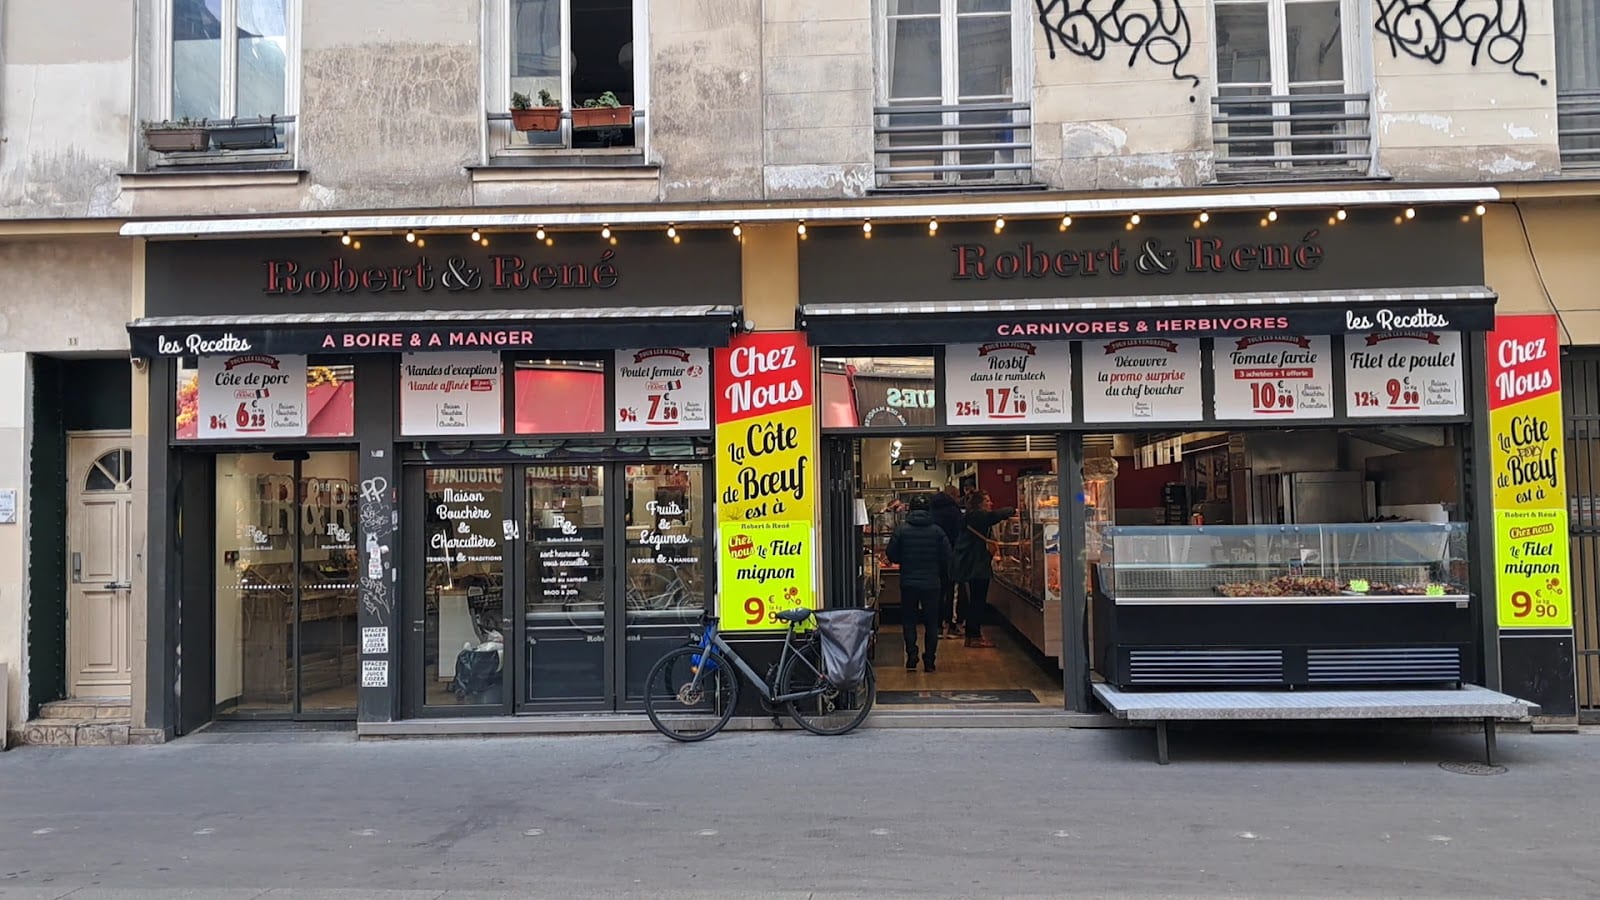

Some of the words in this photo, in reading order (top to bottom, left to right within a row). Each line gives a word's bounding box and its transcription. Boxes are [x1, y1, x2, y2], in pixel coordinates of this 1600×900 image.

[951, 240, 1127, 280] Robert
[1136, 237, 1176, 274] &
[1186, 230, 1324, 272] René
[263, 256, 434, 294] Robert
[442, 255, 482, 291] &
[489, 250, 618, 290] René
[997, 321, 1130, 336] CARNIVORES
[1136, 321, 1149, 332] &
[1156, 317, 1289, 332] HERBIVORES
[1346, 310, 1374, 330] les
[1376, 308, 1449, 331] Recettes
[158, 335, 183, 354] les
[186, 333, 252, 355] Recettes
[322, 335, 336, 348] A
[343, 333, 403, 347] BOIRE
[410, 334, 422, 347] &
[428, 334, 442, 346] A
[450, 331, 534, 346] MANGER
[729, 345, 796, 378] Chez
[1114, 355, 1168, 368] Découvrez
[1230, 351, 1278, 365] Tomate
[1278, 350, 1318, 368] farcie
[1498, 337, 1547, 368] Chez
[405, 364, 442, 377] Viandes
[443, 363, 498, 378] d'exceptions
[988, 355, 1029, 372] Rosbif
[1350, 352, 1383, 369] Filet
[1387, 353, 1406, 368] de
[1409, 352, 1455, 373] poulet
[215, 371, 241, 386] Côte
[244, 372, 260, 385] de
[261, 373, 290, 388] porc
[620, 366, 650, 378] Poulet
[650, 366, 686, 380] fermier
[970, 372, 994, 382] dans
[994, 372, 1003, 382] le
[1097, 371, 1108, 382] la
[1109, 372, 1143, 384] promo
[1145, 370, 1186, 384] surprise
[408, 380, 438, 391] Viande
[439, 380, 469, 393] affinée
[1105, 386, 1119, 396] du
[1121, 384, 1143, 399] chef
[1144, 384, 1185, 396] boucher
[1386, 378, 1401, 405] 9
[1495, 368, 1553, 401] Nous
[724, 379, 803, 414] Nous
[985, 388, 1011, 414] 17
[1250, 382, 1275, 408] 10
[236, 402, 249, 427] 6
[648, 394, 661, 420] 7
[727, 442, 745, 465] La
[747, 421, 798, 457] Côte
[1497, 432, 1511, 454] La
[1511, 415, 1550, 446] Côte
[1497, 472, 1511, 488] de
[1507, 447, 1559, 488] Bœuf
[722, 485, 739, 504] de
[737, 455, 808, 501] Bœuf
[443, 487, 485, 503] Maison
[1516, 488, 1532, 504] est
[1536, 485, 1546, 500] à
[436, 504, 492, 520] Bouchère
[645, 500, 683, 516] Fruits
[745, 502, 767, 519] est
[773, 498, 787, 514] à
[457, 521, 471, 534] &
[658, 518, 671, 530] &
[1510, 527, 1531, 539] Chez
[1532, 524, 1553, 535] nous
[431, 533, 497, 549] Charcutière
[639, 529, 690, 551] Légumes
[729, 535, 752, 547] Chez
[770, 539, 803, 556] Filet
[1522, 541, 1553, 556] Filet
[456, 552, 467, 562] &
[656, 553, 667, 563] &
[731, 547, 755, 558] nous
[736, 564, 795, 584] mignon
[1504, 560, 1560, 578] mignon
[744, 597, 765, 626] 9
[768, 595, 775, 604] €
[1511, 591, 1532, 618] 9
[1535, 590, 1542, 598] €
[1535, 604, 1558, 618] 90
